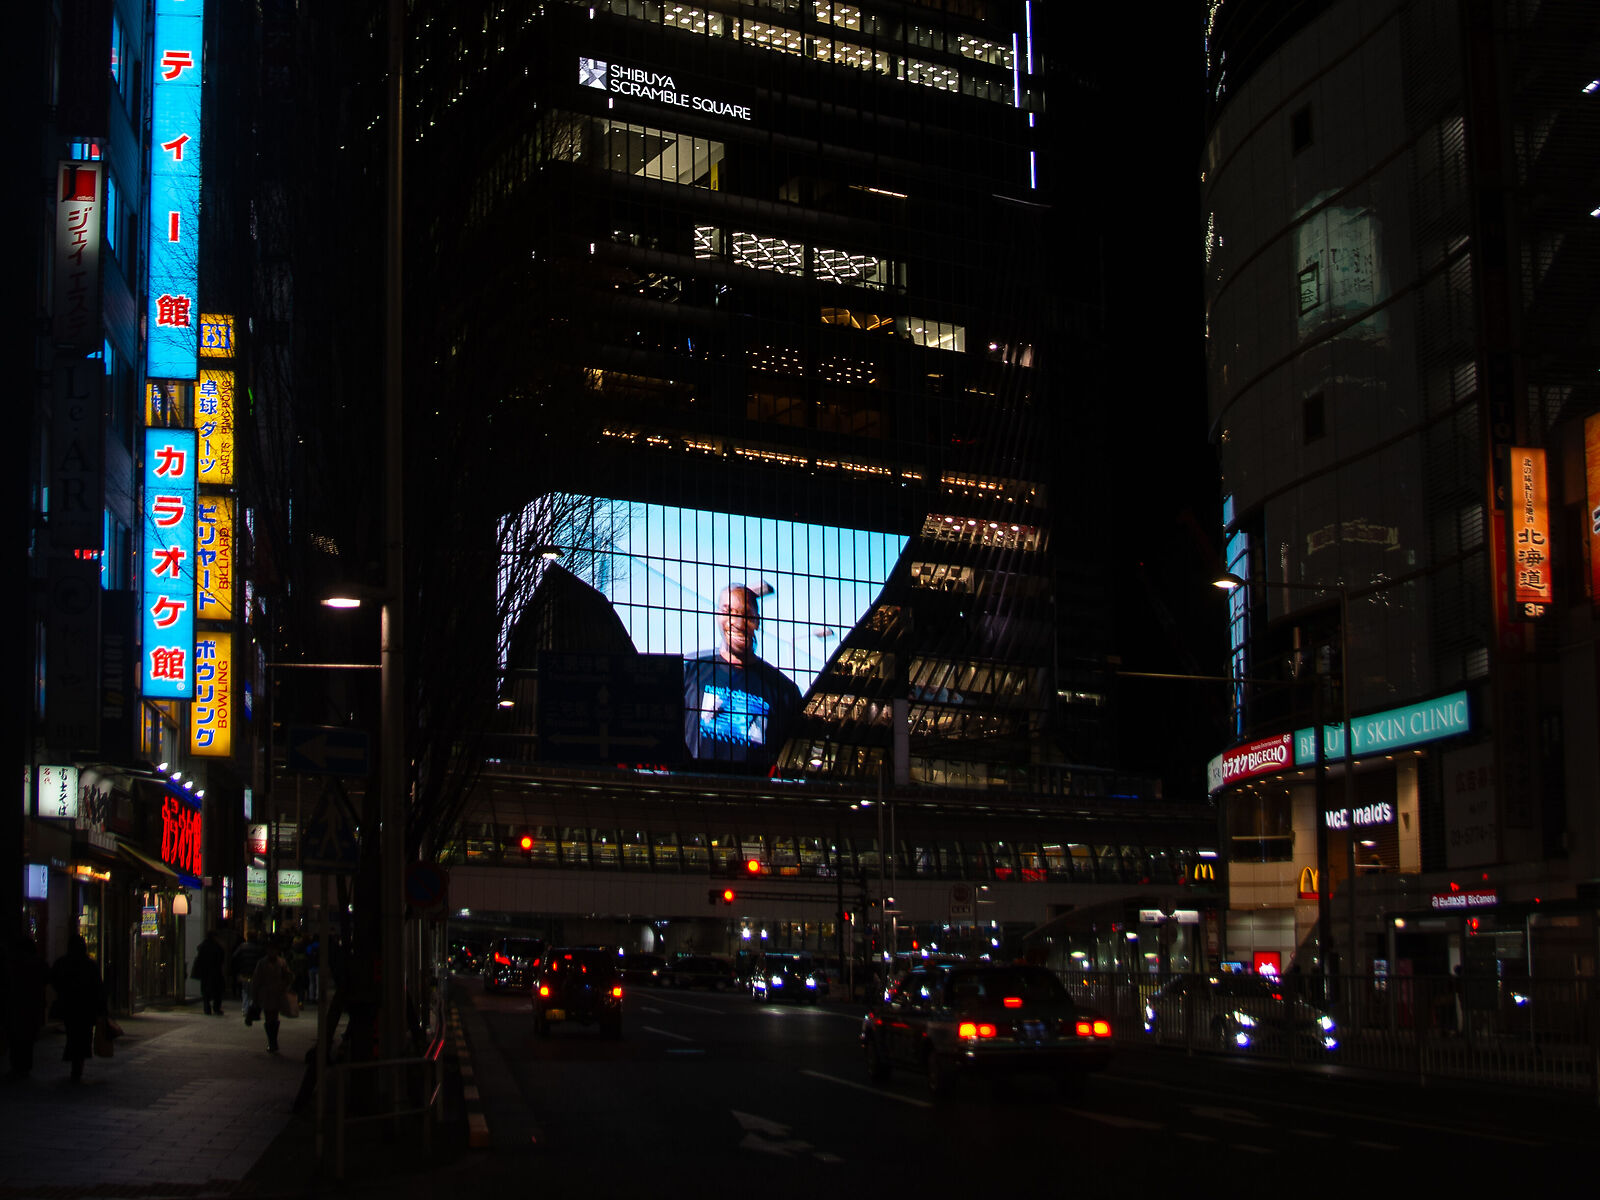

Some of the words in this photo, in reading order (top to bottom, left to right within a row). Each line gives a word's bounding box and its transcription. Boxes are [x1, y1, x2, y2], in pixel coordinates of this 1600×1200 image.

[610, 64, 676, 89] SHIBUYA
[610, 79, 690, 108] SCRAMBLE
[692, 97, 752, 120] SQUARE
[199, 380, 218, 415] 卓球
[198, 421, 217, 474] ダーツ
[220, 442, 231, 475] DARTS
[150, 445, 187, 681] カラオケ館
[196, 504, 217, 611] ビリヤード
[217, 526, 230, 591] BILLIARD
[1518, 528, 1546, 590] 北海道
[1524, 603, 1546, 617] 3F
[195, 640, 216, 748] ボウリング
[217, 660, 229, 730] BOWLING
[1301, 726, 1363, 757] BEUY
[1367, 716, 1405, 745] SKIN
[1410, 701, 1465, 736] CLINIC
[1222, 753, 1248, 778] カラオケ
[1325, 802, 1392, 828] McDnald's
